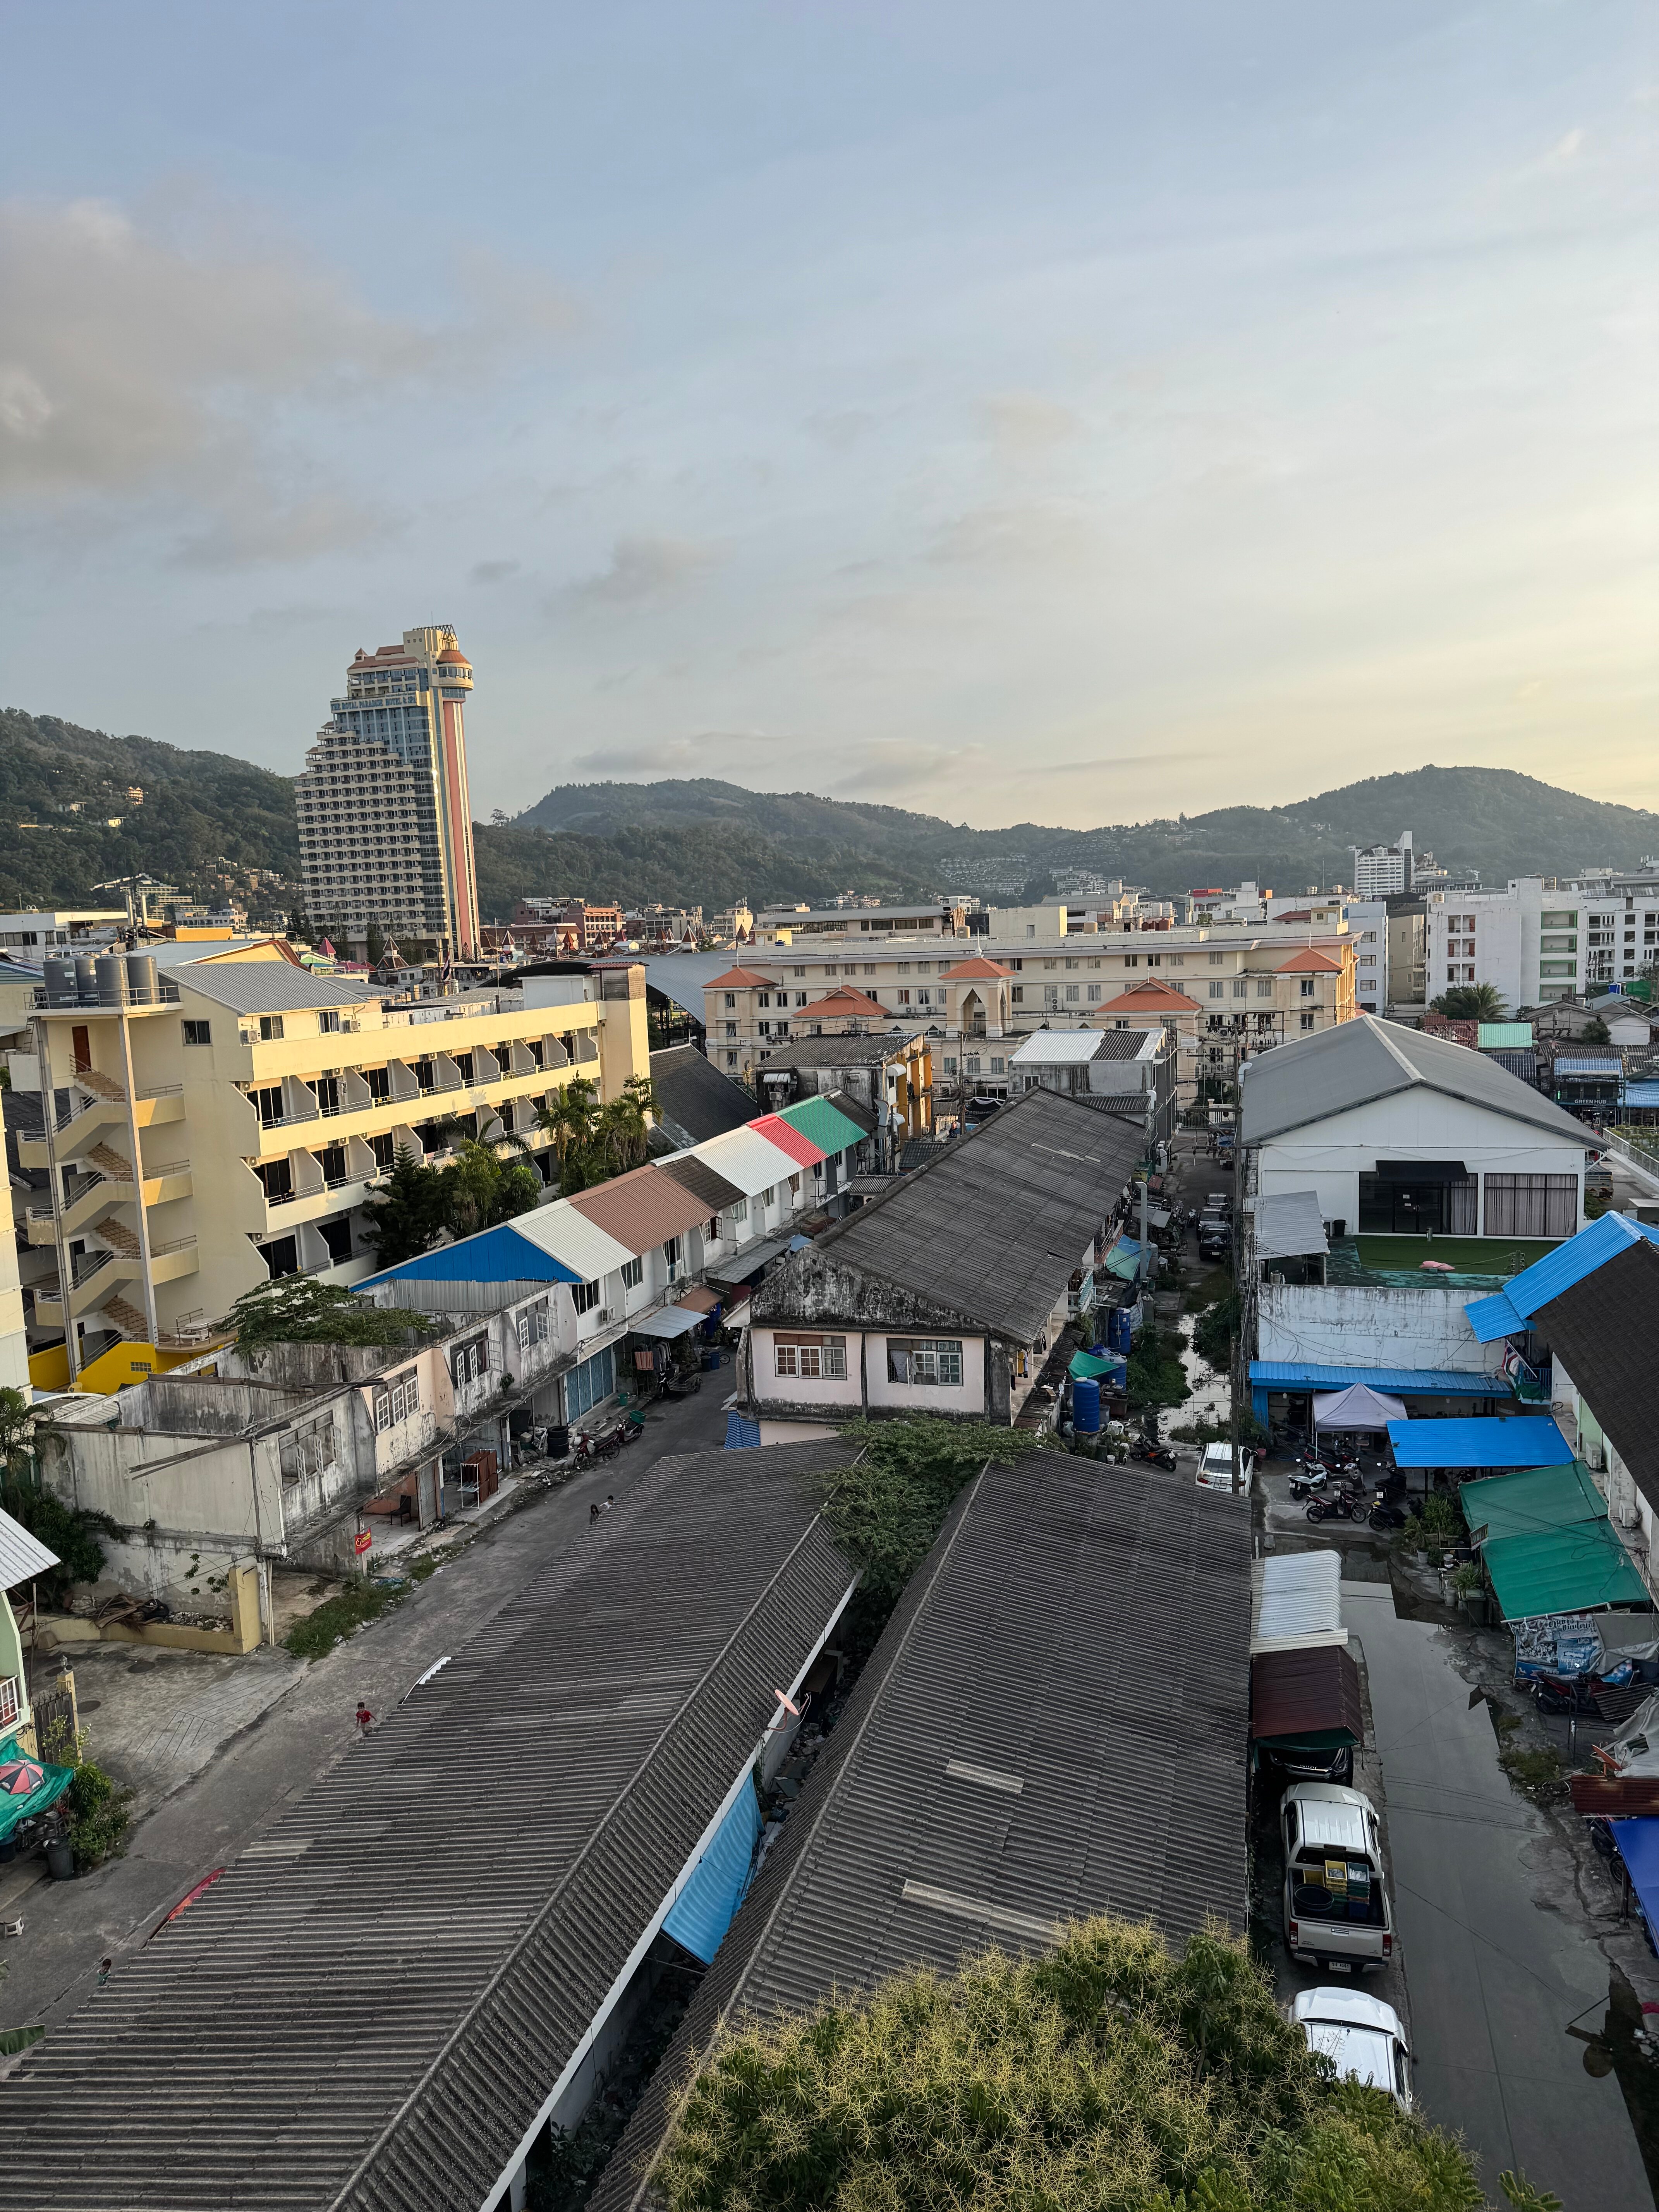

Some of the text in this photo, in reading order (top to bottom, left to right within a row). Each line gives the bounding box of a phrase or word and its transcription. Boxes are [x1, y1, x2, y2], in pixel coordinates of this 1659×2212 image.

[342, 701, 358, 710] ROYAL
[359, 699, 383, 708] PARADISE
[386, 697, 402, 706] HOTEL
[407, 696, 417, 704] SPA
